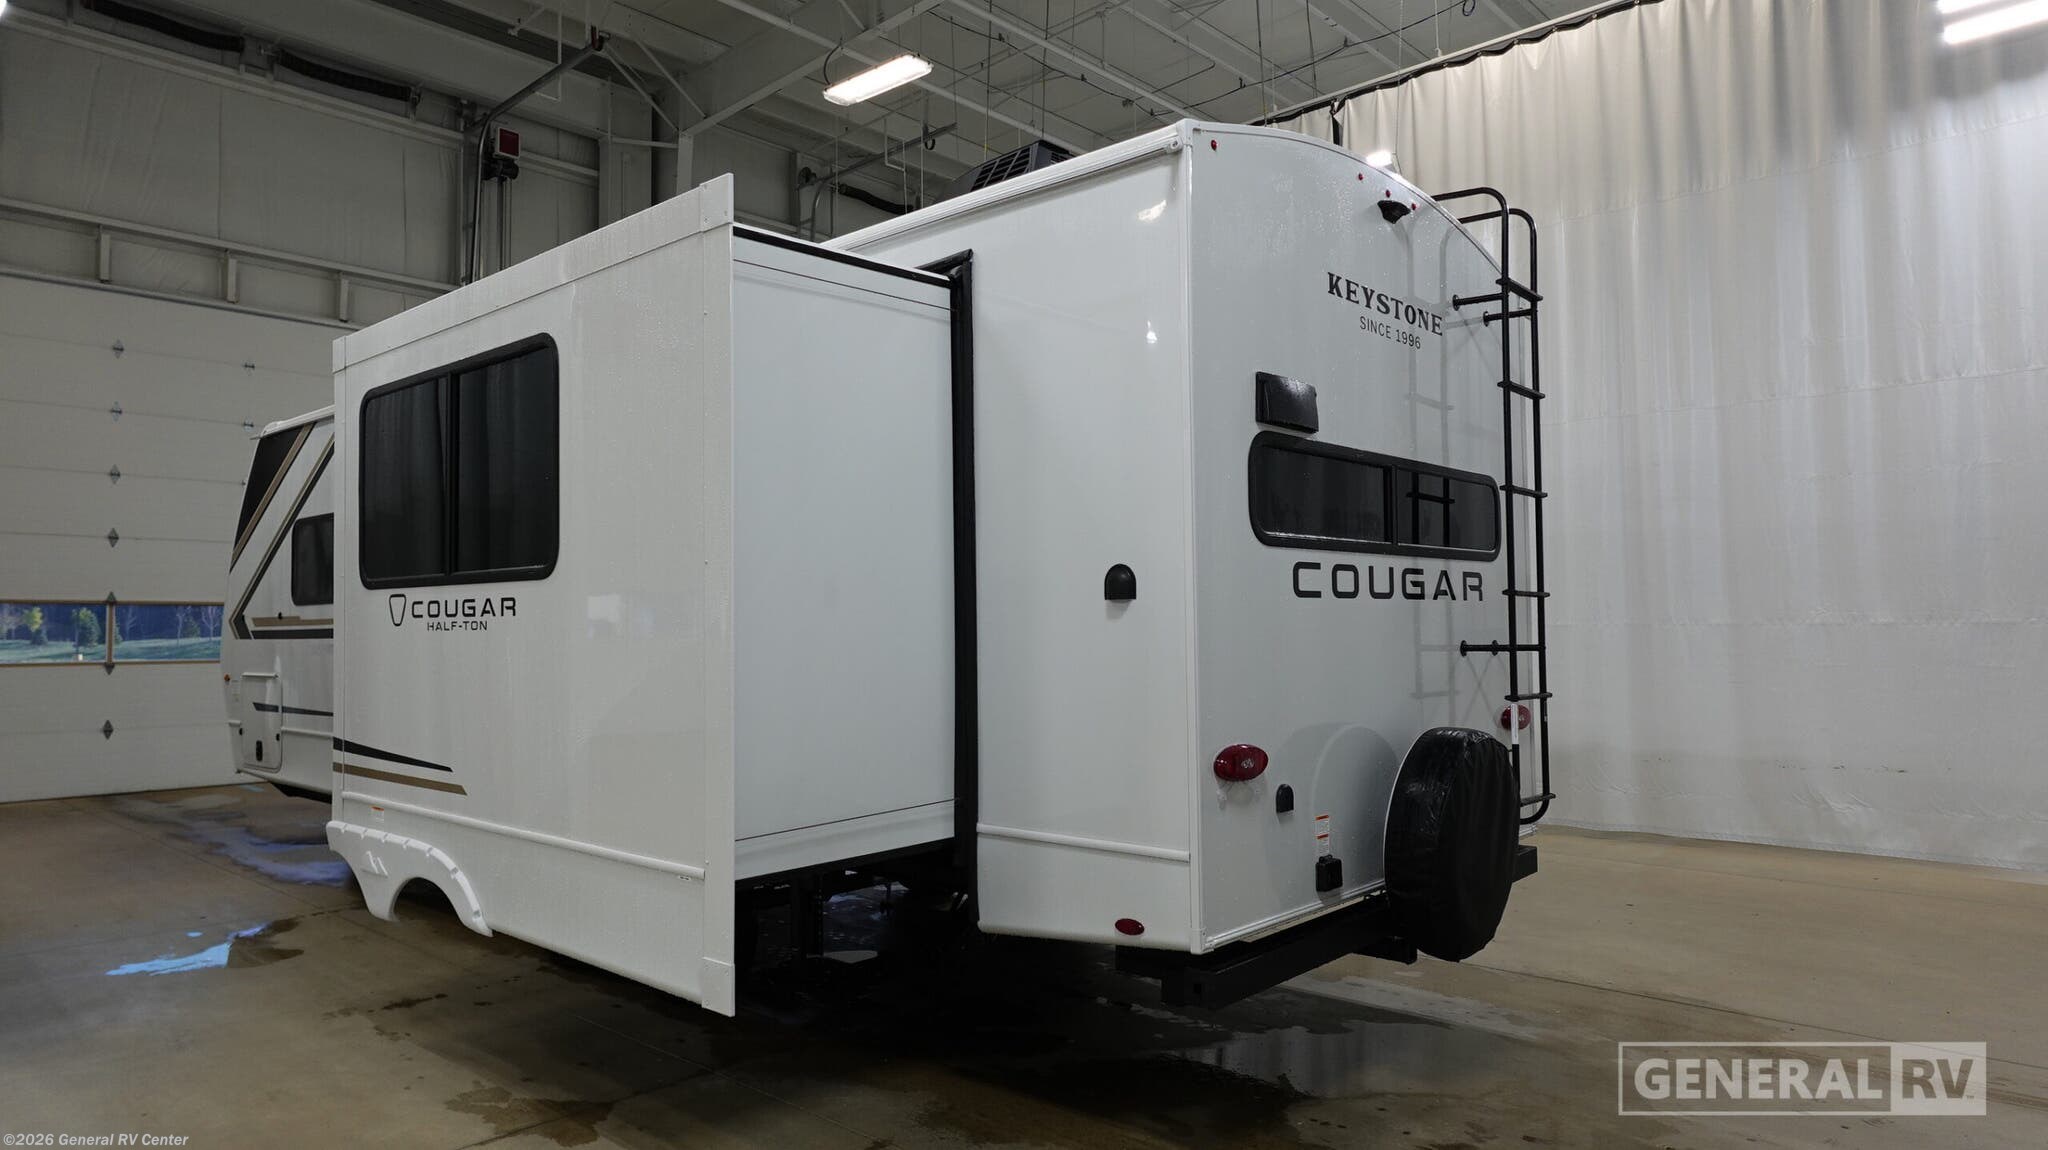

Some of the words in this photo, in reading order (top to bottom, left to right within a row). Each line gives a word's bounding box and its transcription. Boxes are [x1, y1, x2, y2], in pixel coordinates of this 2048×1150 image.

[1327, 271, 1443, 336] KEYSTONE
[1360, 316, 1392, 339] SINCE
[1395, 329, 1421, 350] 1996
[1293, 561, 1483, 601] COUGAR
[411, 597, 516, 619] COUGAR
[427, 620, 488, 631] HALF-TON
